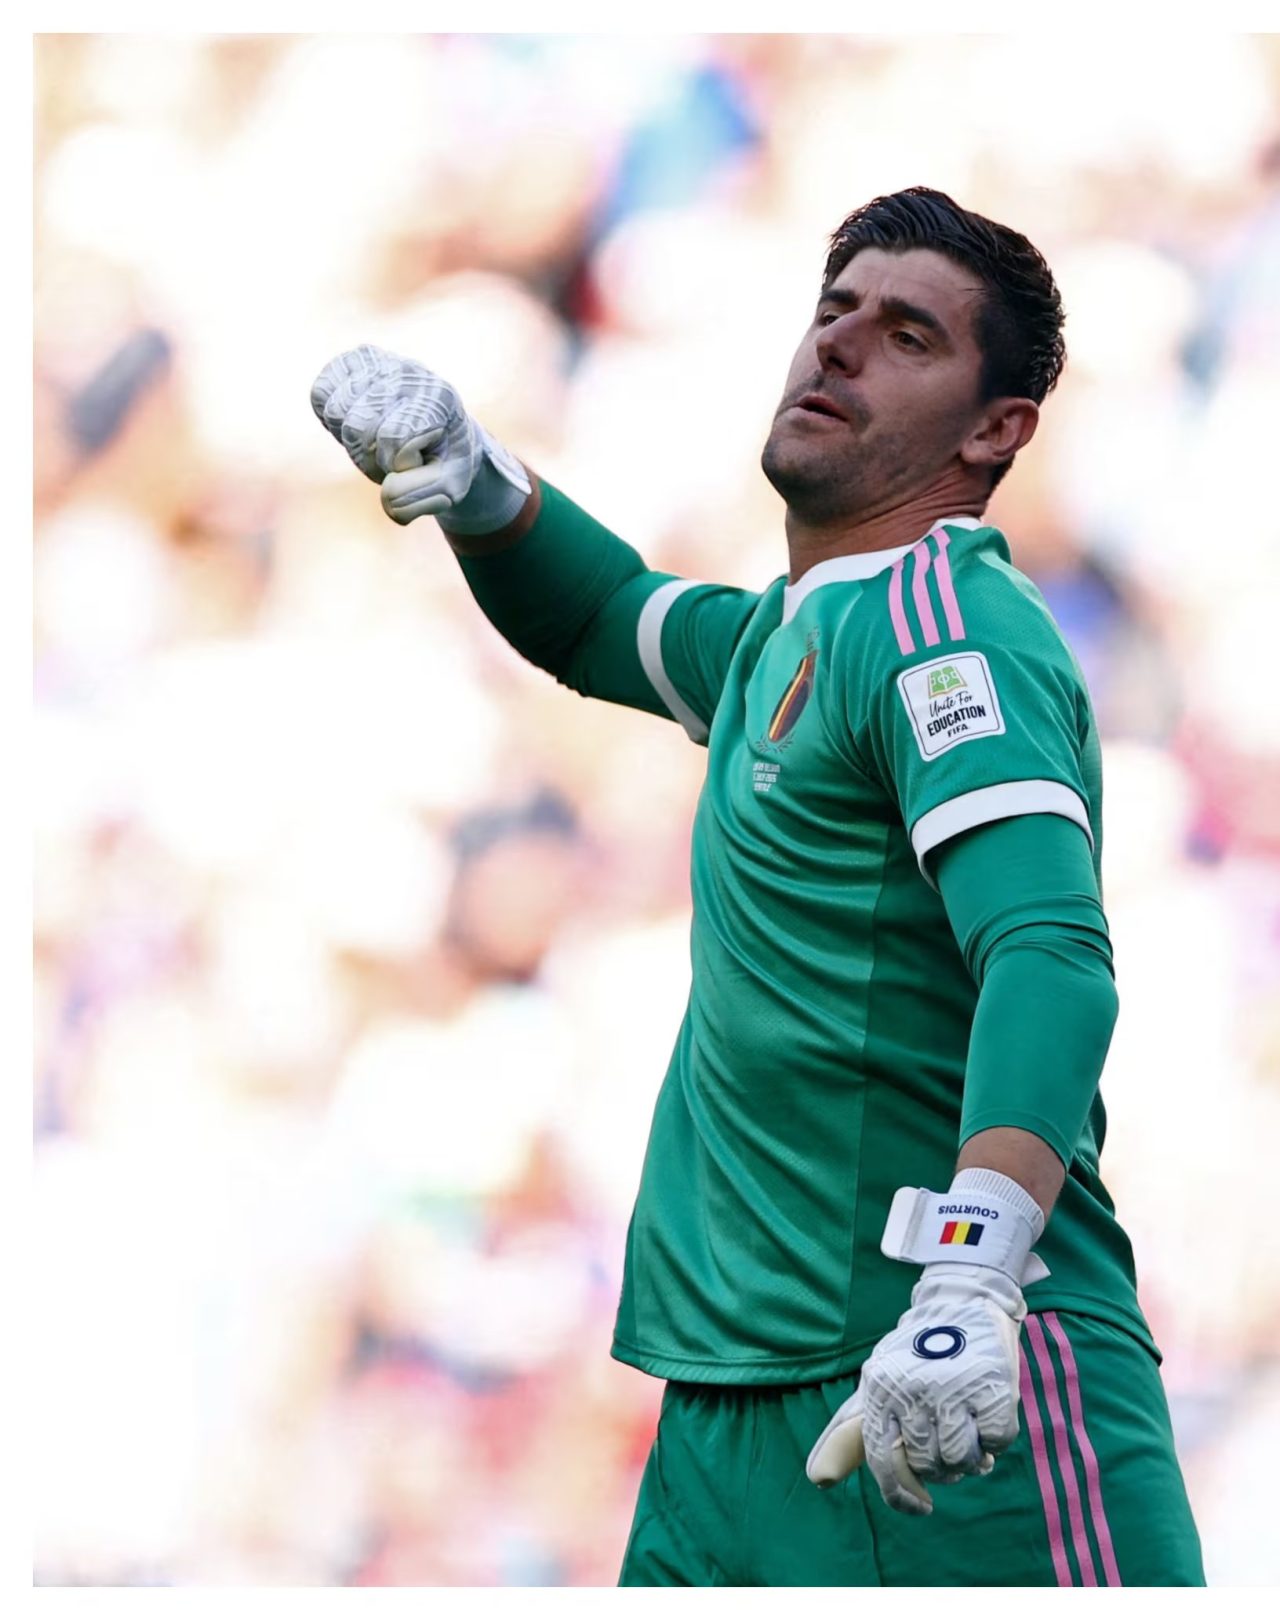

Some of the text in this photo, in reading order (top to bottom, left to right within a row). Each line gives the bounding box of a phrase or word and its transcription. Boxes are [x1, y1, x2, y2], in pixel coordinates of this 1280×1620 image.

[929, 690, 973, 718] Unite For
[926, 704, 987, 737] EDUCATION
[947, 723, 969, 738] FIFA
[938, 1204, 999, 1220] COURTOIS
